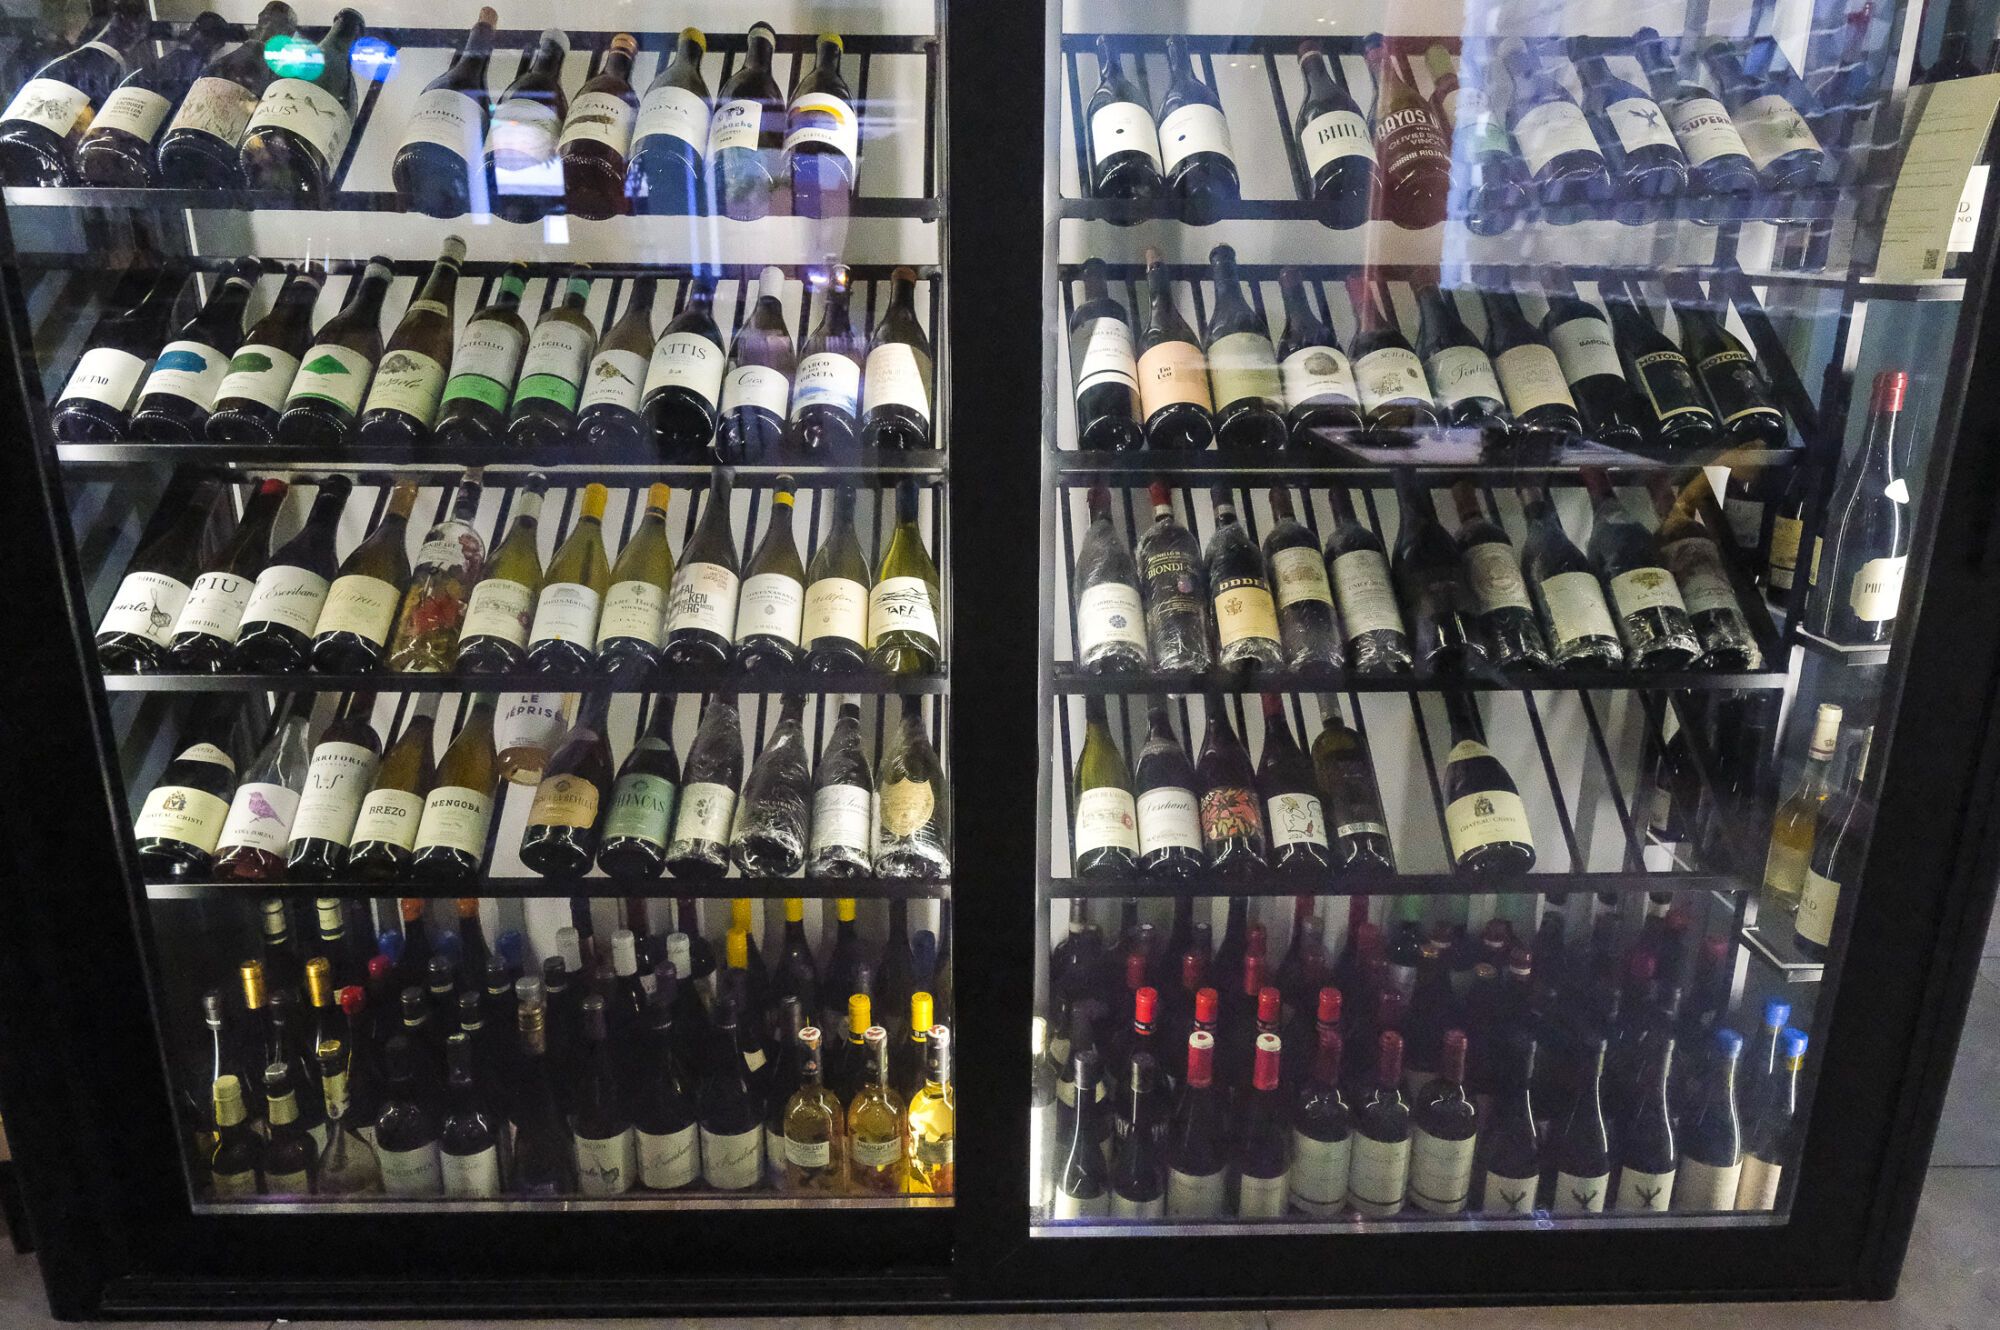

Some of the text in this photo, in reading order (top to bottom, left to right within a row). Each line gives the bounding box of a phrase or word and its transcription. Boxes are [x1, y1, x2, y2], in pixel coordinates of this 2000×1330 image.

[1959, 202, 1970, 213] D
[660, 343, 706, 360] ATTIS
[688, 593, 708, 603] KEN
[521, 694, 539, 704] LE
[369, 806, 407, 818] BREZO
[430, 799, 481, 815] MENGOBA
